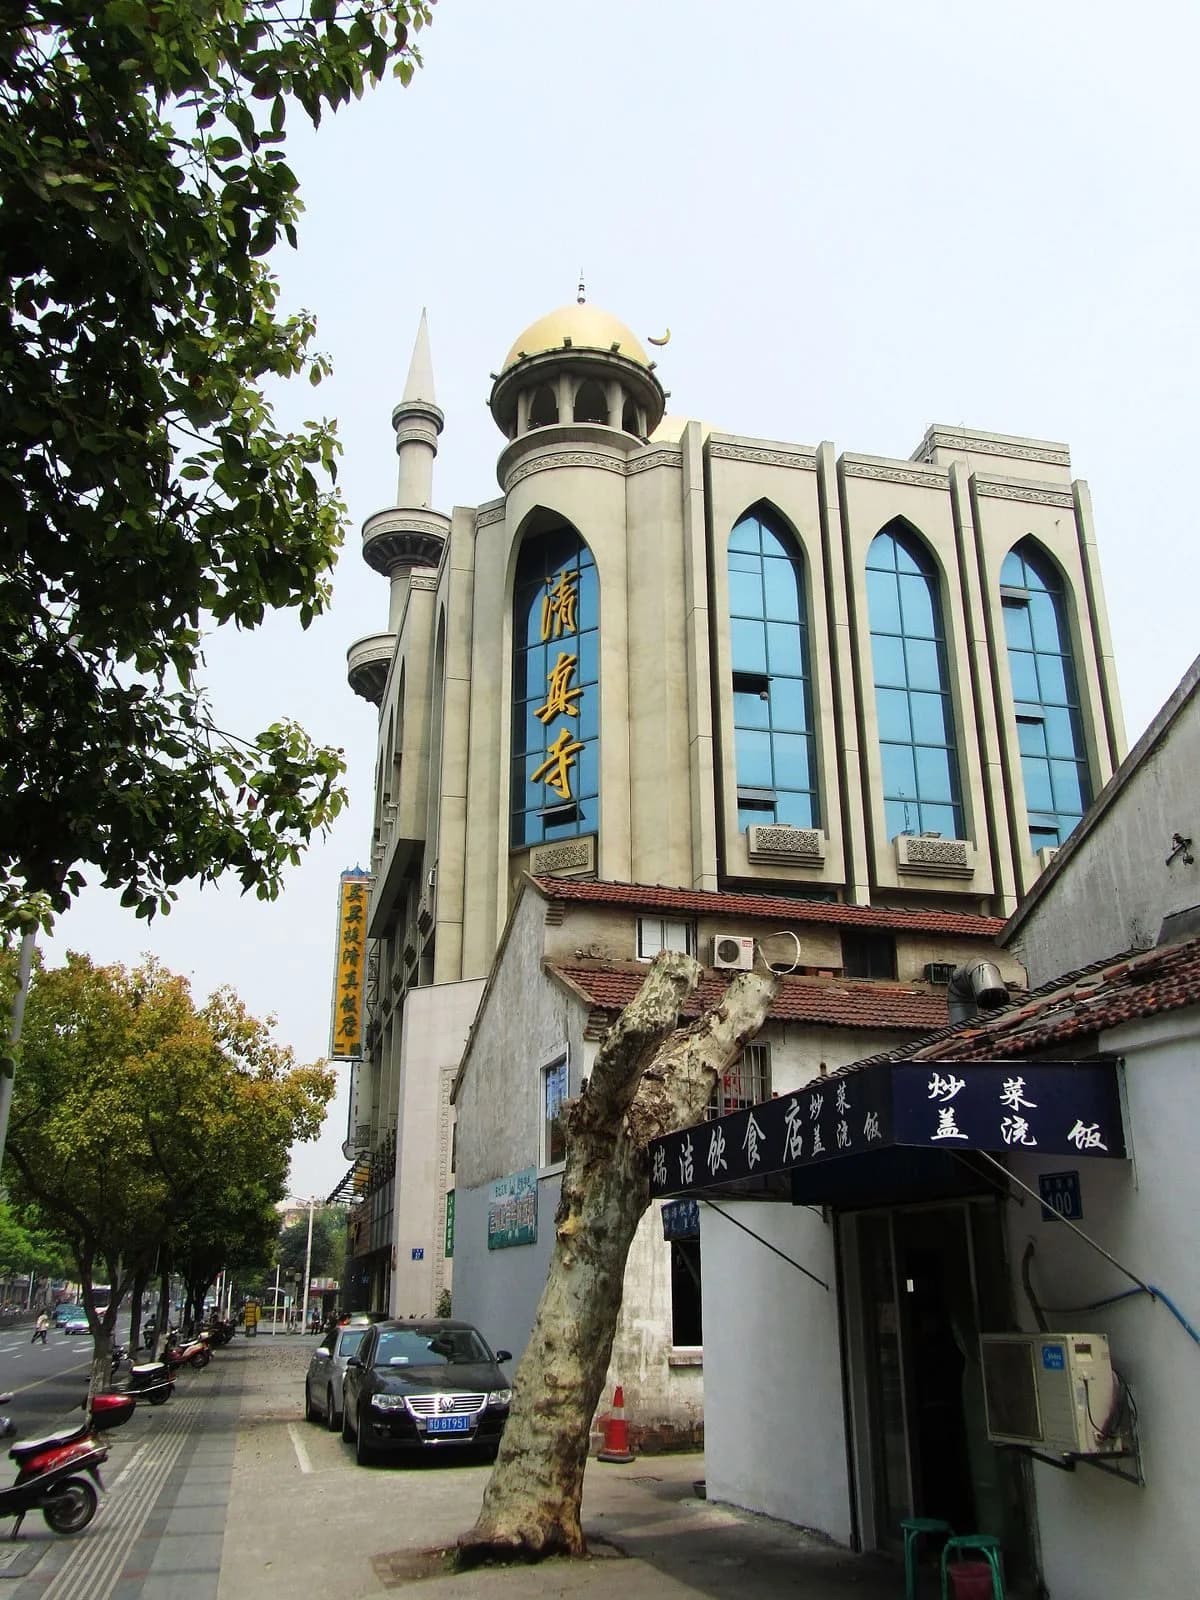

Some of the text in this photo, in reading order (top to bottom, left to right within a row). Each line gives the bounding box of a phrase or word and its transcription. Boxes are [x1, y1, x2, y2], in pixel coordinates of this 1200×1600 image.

[531, 570, 584, 800] 清真寺
[809, 1081, 851, 1120] 炒菜
[928, 1072, 1038, 1112] 炒菜
[653, 1098, 803, 1187] 瑞洁饮食店
[930, 1106, 1108, 1151] 盖浇饭
